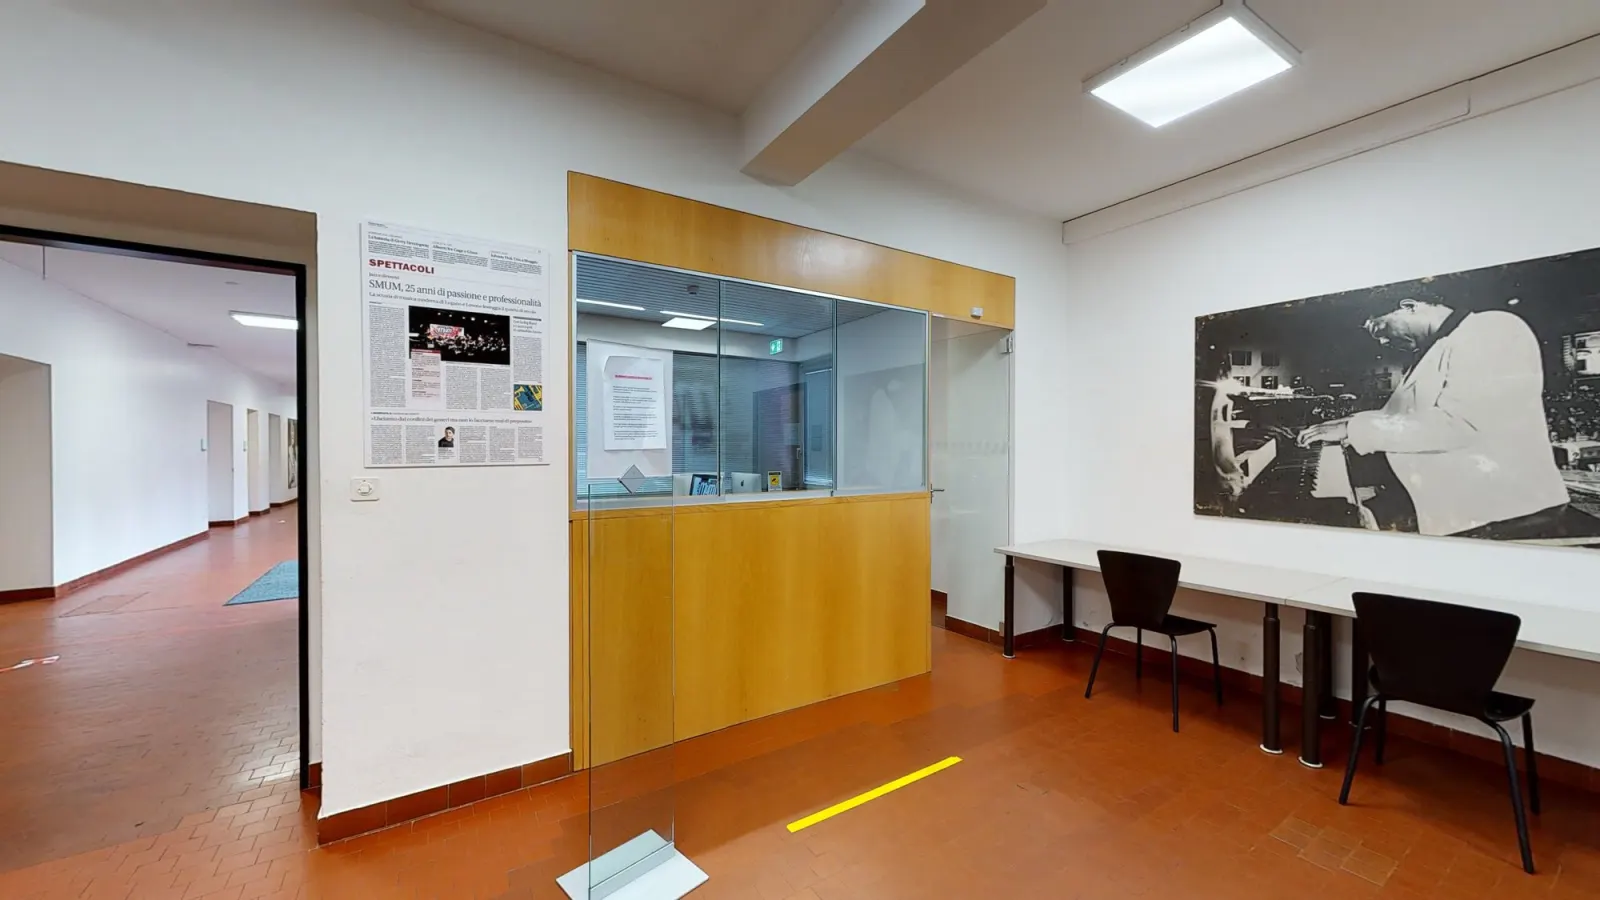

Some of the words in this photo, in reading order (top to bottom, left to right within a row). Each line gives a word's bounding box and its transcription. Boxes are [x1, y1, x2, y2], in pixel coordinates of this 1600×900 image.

[368, 258, 435, 275] SPETTACOLI
[368, 279, 404, 292] SMUM,
[405, 283, 416, 293] 25
[416, 285, 436, 295] anni
[436, 287, 446, 296] di
[446, 289, 482, 301] passione
[488, 294, 542, 308] professionalità
